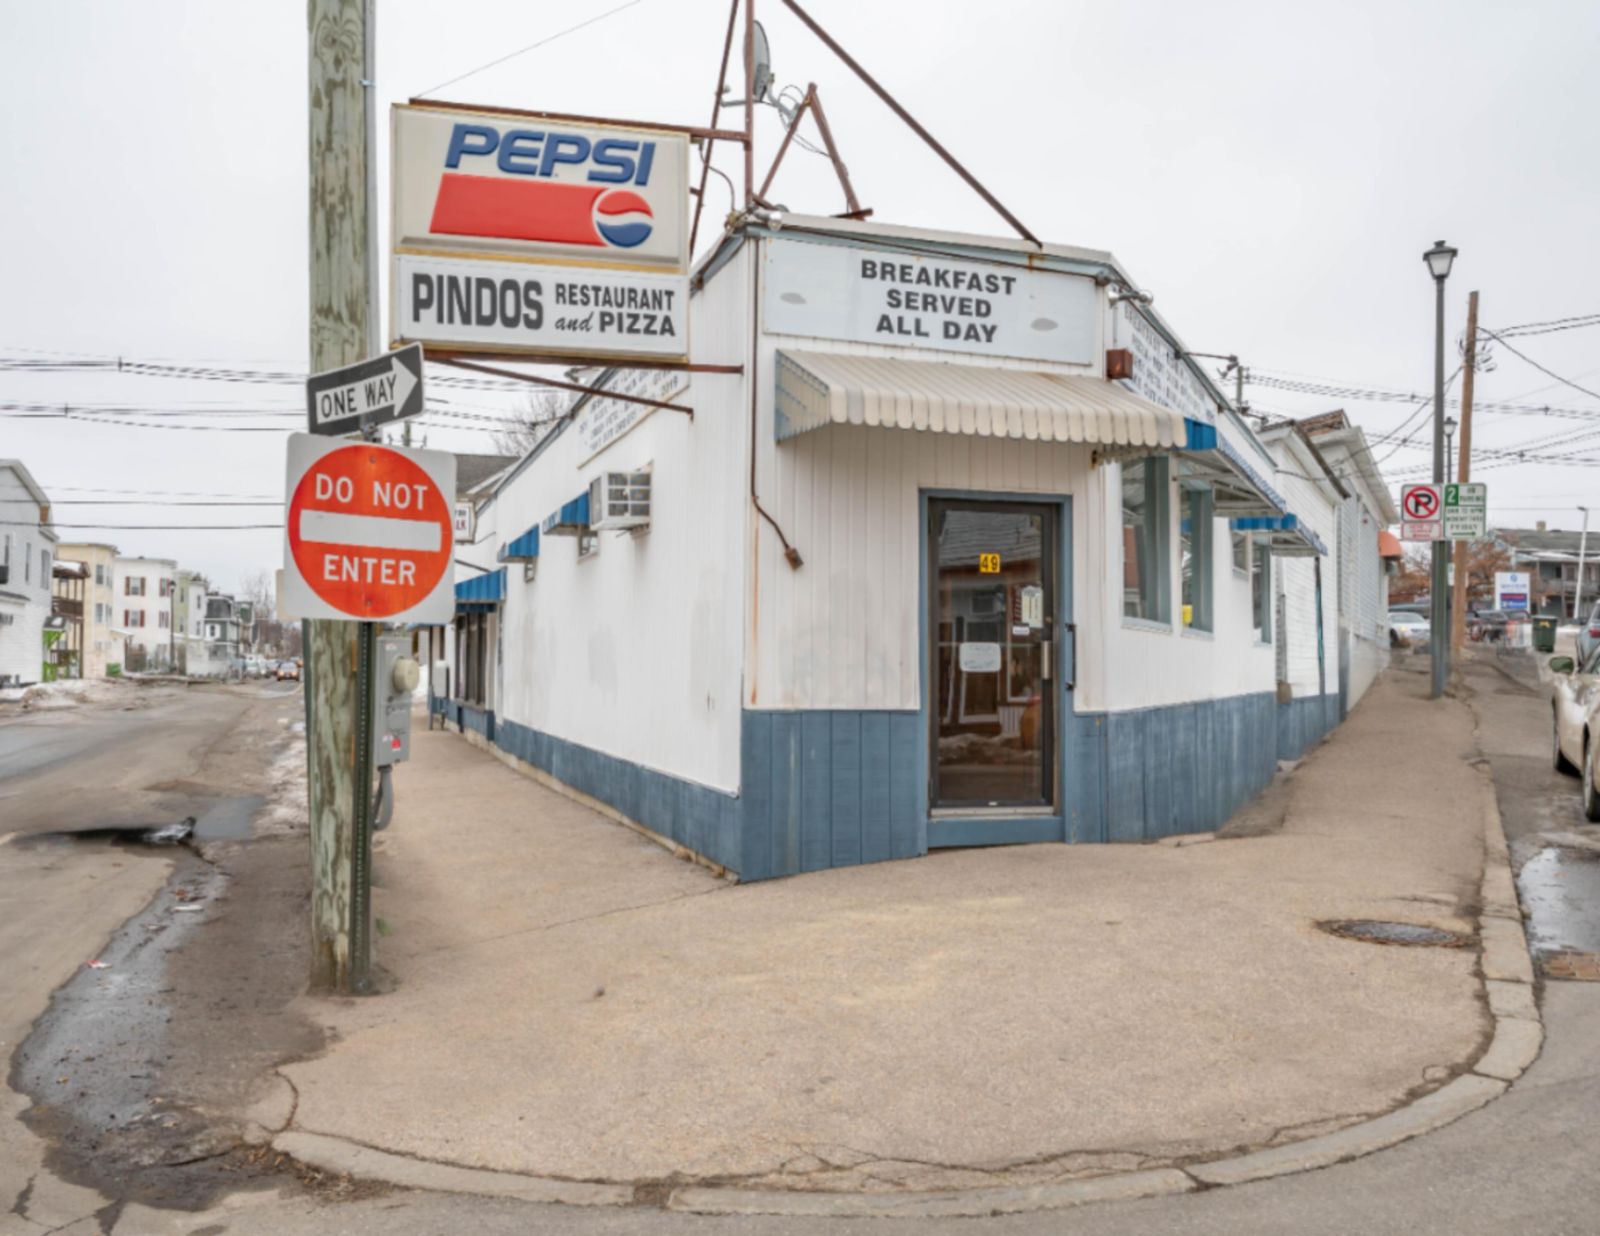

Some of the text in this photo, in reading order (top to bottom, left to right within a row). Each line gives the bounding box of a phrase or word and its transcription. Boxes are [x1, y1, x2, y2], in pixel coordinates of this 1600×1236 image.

[444, 123, 656, 187] PEPSI
[861, 259, 1016, 295] BREAKFAST
[412, 272, 544, 330] PINDOS
[555, 283, 675, 311] RESTAURANT
[886, 288, 992, 319] SERVED
[554, 311, 676, 337] and PIZZA
[876, 313, 998, 343] ALL DAY
[320, 373, 397, 419] ONE WAY
[315, 473, 428, 510] DO NOT
[1447, 487, 1456, 503] 2
[323, 554, 416, 586] ENTER
[980, 555, 998, 571] 49
